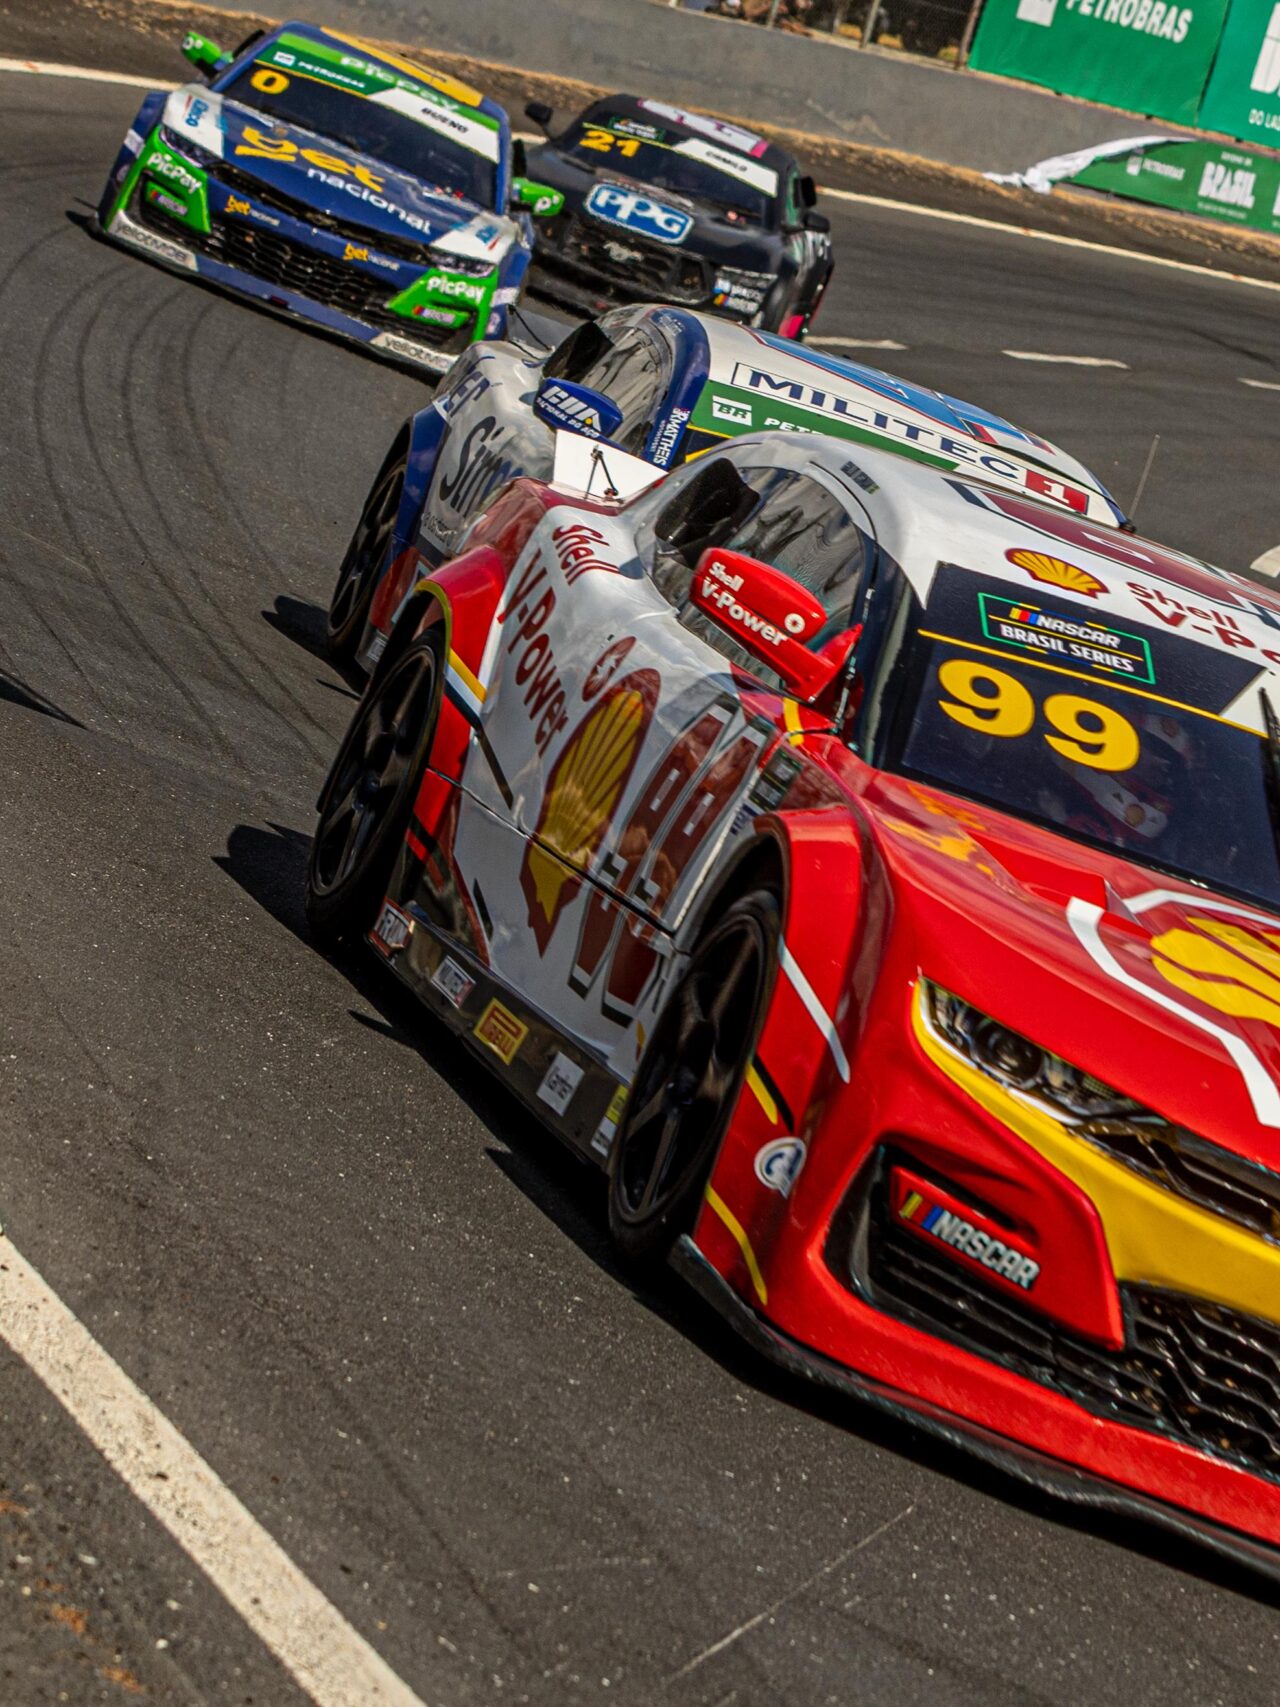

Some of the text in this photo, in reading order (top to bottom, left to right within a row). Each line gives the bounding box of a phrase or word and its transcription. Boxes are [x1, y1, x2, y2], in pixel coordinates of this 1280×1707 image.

[250, 68, 290, 94] 0
[1249, 108, 1264, 126] DO
[578, 130, 641, 158] 21
[146, 152, 203, 194] PicPay
[1198, 161, 1257, 209] BRASIL
[307, 168, 432, 235] nacional
[594, 188, 687, 236] PPG
[426, 275, 487, 305] PicPay
[749, 369, 1020, 479] MILITEC
[1043, 479, 1070, 504] 1
[763, 417, 826, 436] PET
[552, 524, 621, 587] Shell
[708, 561, 745, 593] Shell
[701, 575, 790, 647] V-Power
[1126, 581, 1240, 631] Shell
[497, 547, 569, 759] V-Power
[1000, 623, 1135, 673] BRASIL SERIES
[1036, 614, 1122, 649] NASCAR
[937, 658, 1140, 773] 99
[931, 1209, 1041, 1290] NASCAR
